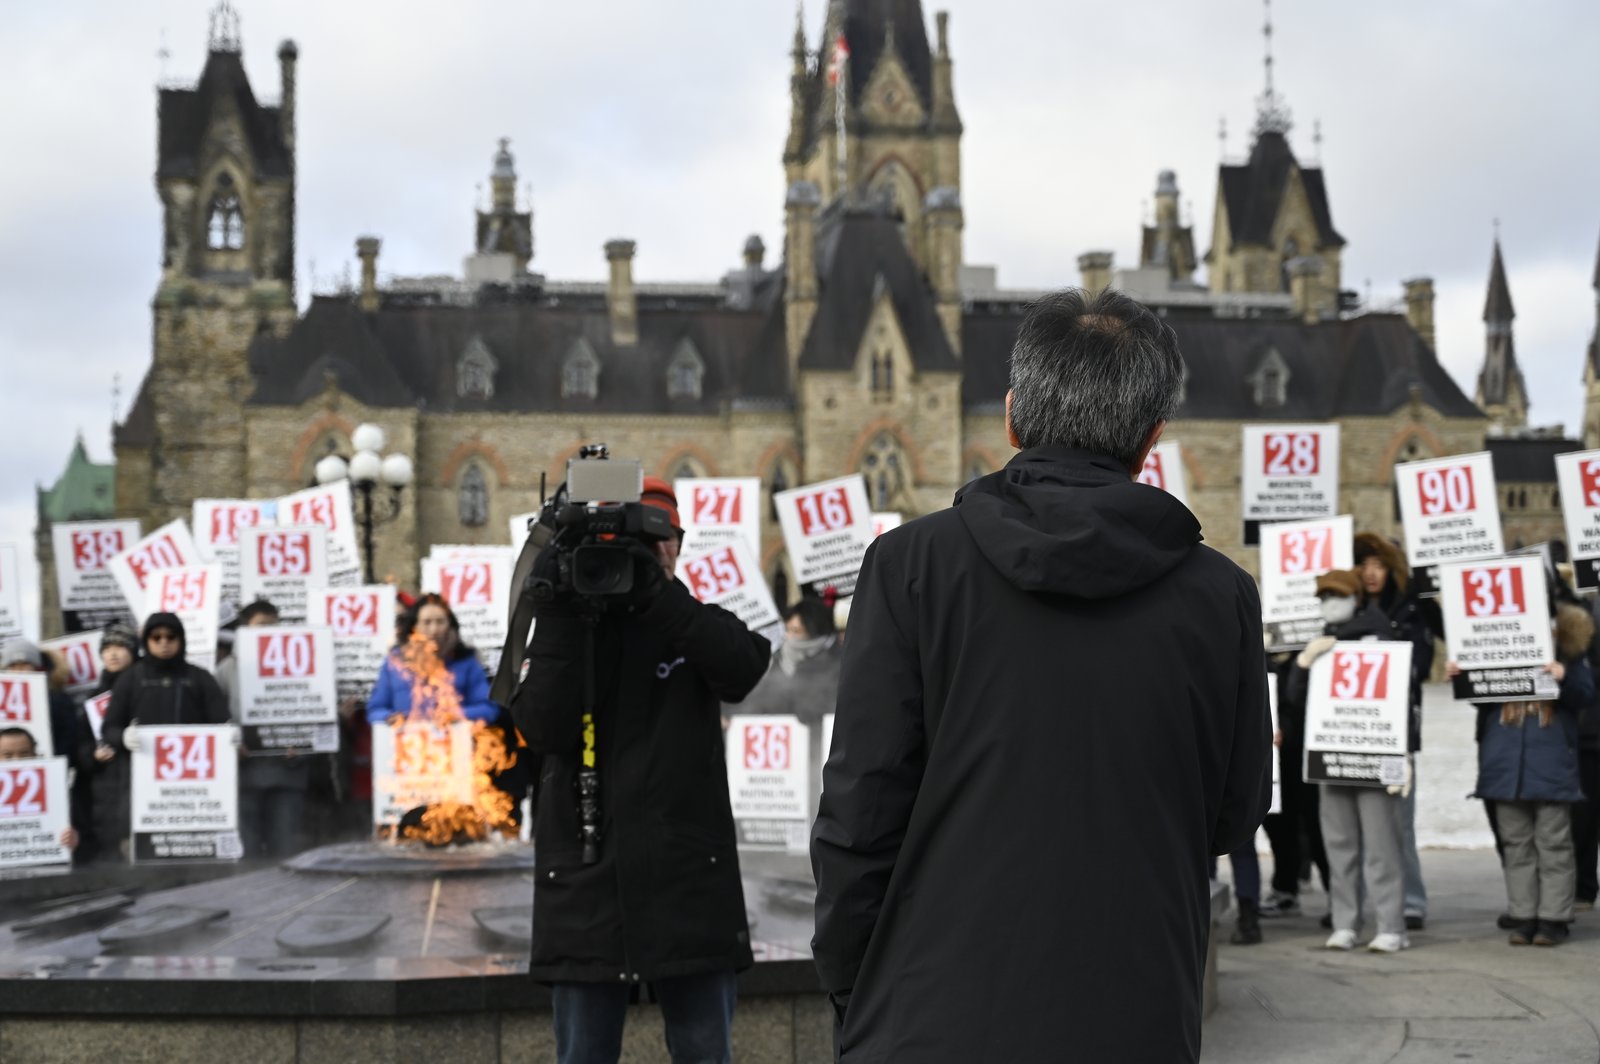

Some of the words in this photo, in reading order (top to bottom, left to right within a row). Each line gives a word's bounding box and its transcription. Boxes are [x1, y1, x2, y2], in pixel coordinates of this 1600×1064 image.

[1269, 435, 1315, 474] 28
[697, 486, 737, 524] 27
[1422, 467, 1470, 513] 90
[1586, 461, 1600, 507] 3
[803, 490, 846, 534] 16
[79, 529, 119, 570] 38
[263, 533, 306, 575] 65
[1285, 529, 1327, 574] 37
[166, 572, 205, 611] 55
[443, 564, 486, 603] 72
[690, 550, 738, 598] 35
[1469, 568, 1521, 616] 31
[331, 593, 373, 636] 62
[1472, 621, 1521, 633] MONTHS
[263, 634, 310, 676] 40
[1462, 636, 1510, 648] WAITING
[1513, 634, 1535, 645] FOR
[1482, 649, 1544, 660] RESPONSE
[1335, 653, 1385, 699] 37
[1322, 719, 1367, 731] WAITING
[1371, 721, 1392, 731] FOR
[1334, 706, 1380, 717] MONTHS
[160, 735, 211, 780] 34
[747, 725, 787, 769] 36
[1339, 734, 1398, 747] RESPONSE
